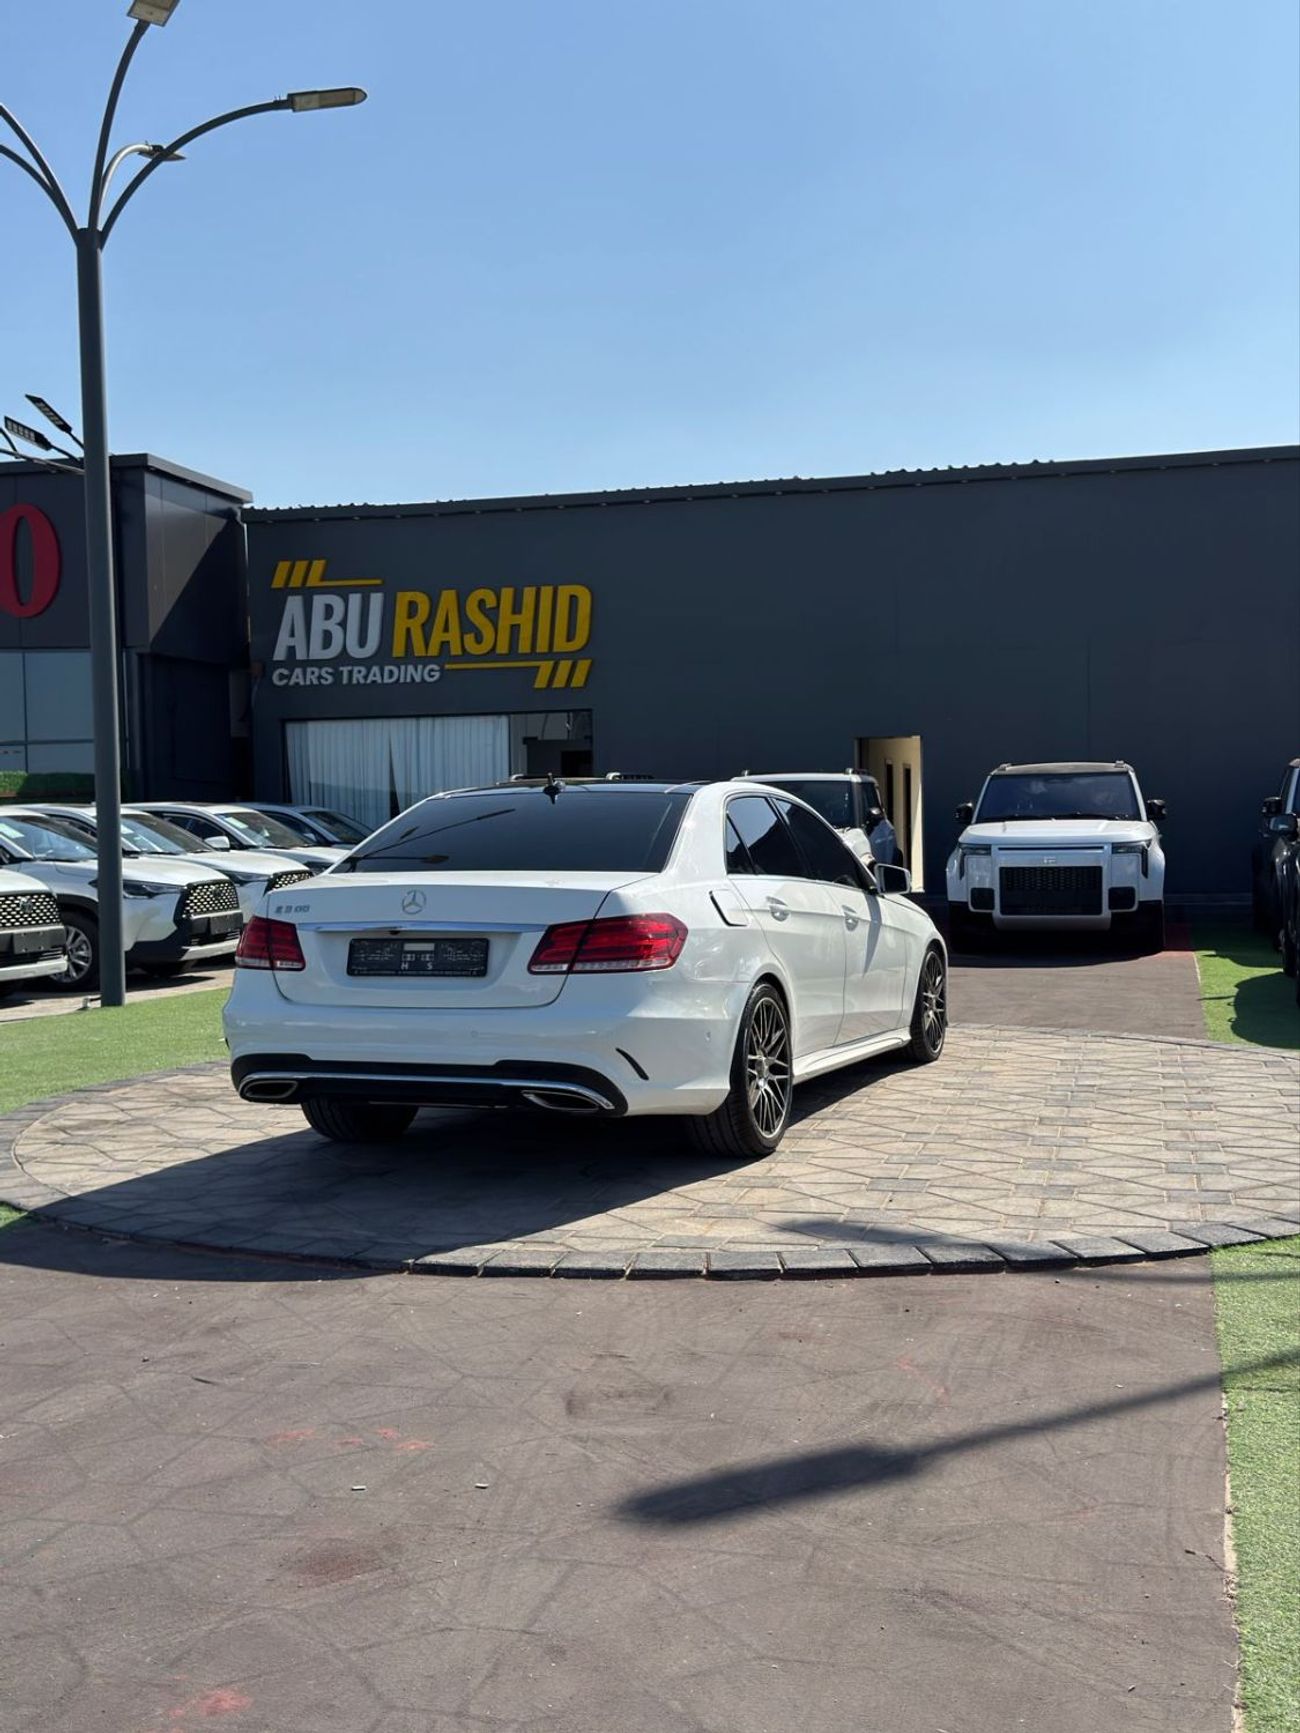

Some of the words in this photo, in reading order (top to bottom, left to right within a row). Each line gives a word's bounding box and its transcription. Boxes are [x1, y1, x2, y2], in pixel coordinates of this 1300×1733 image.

[272, 592, 384, 661] ABU
[392, 585, 592, 658] RASHID
[272, 666, 334, 686] CARS
[339, 664, 441, 685] TRADING
